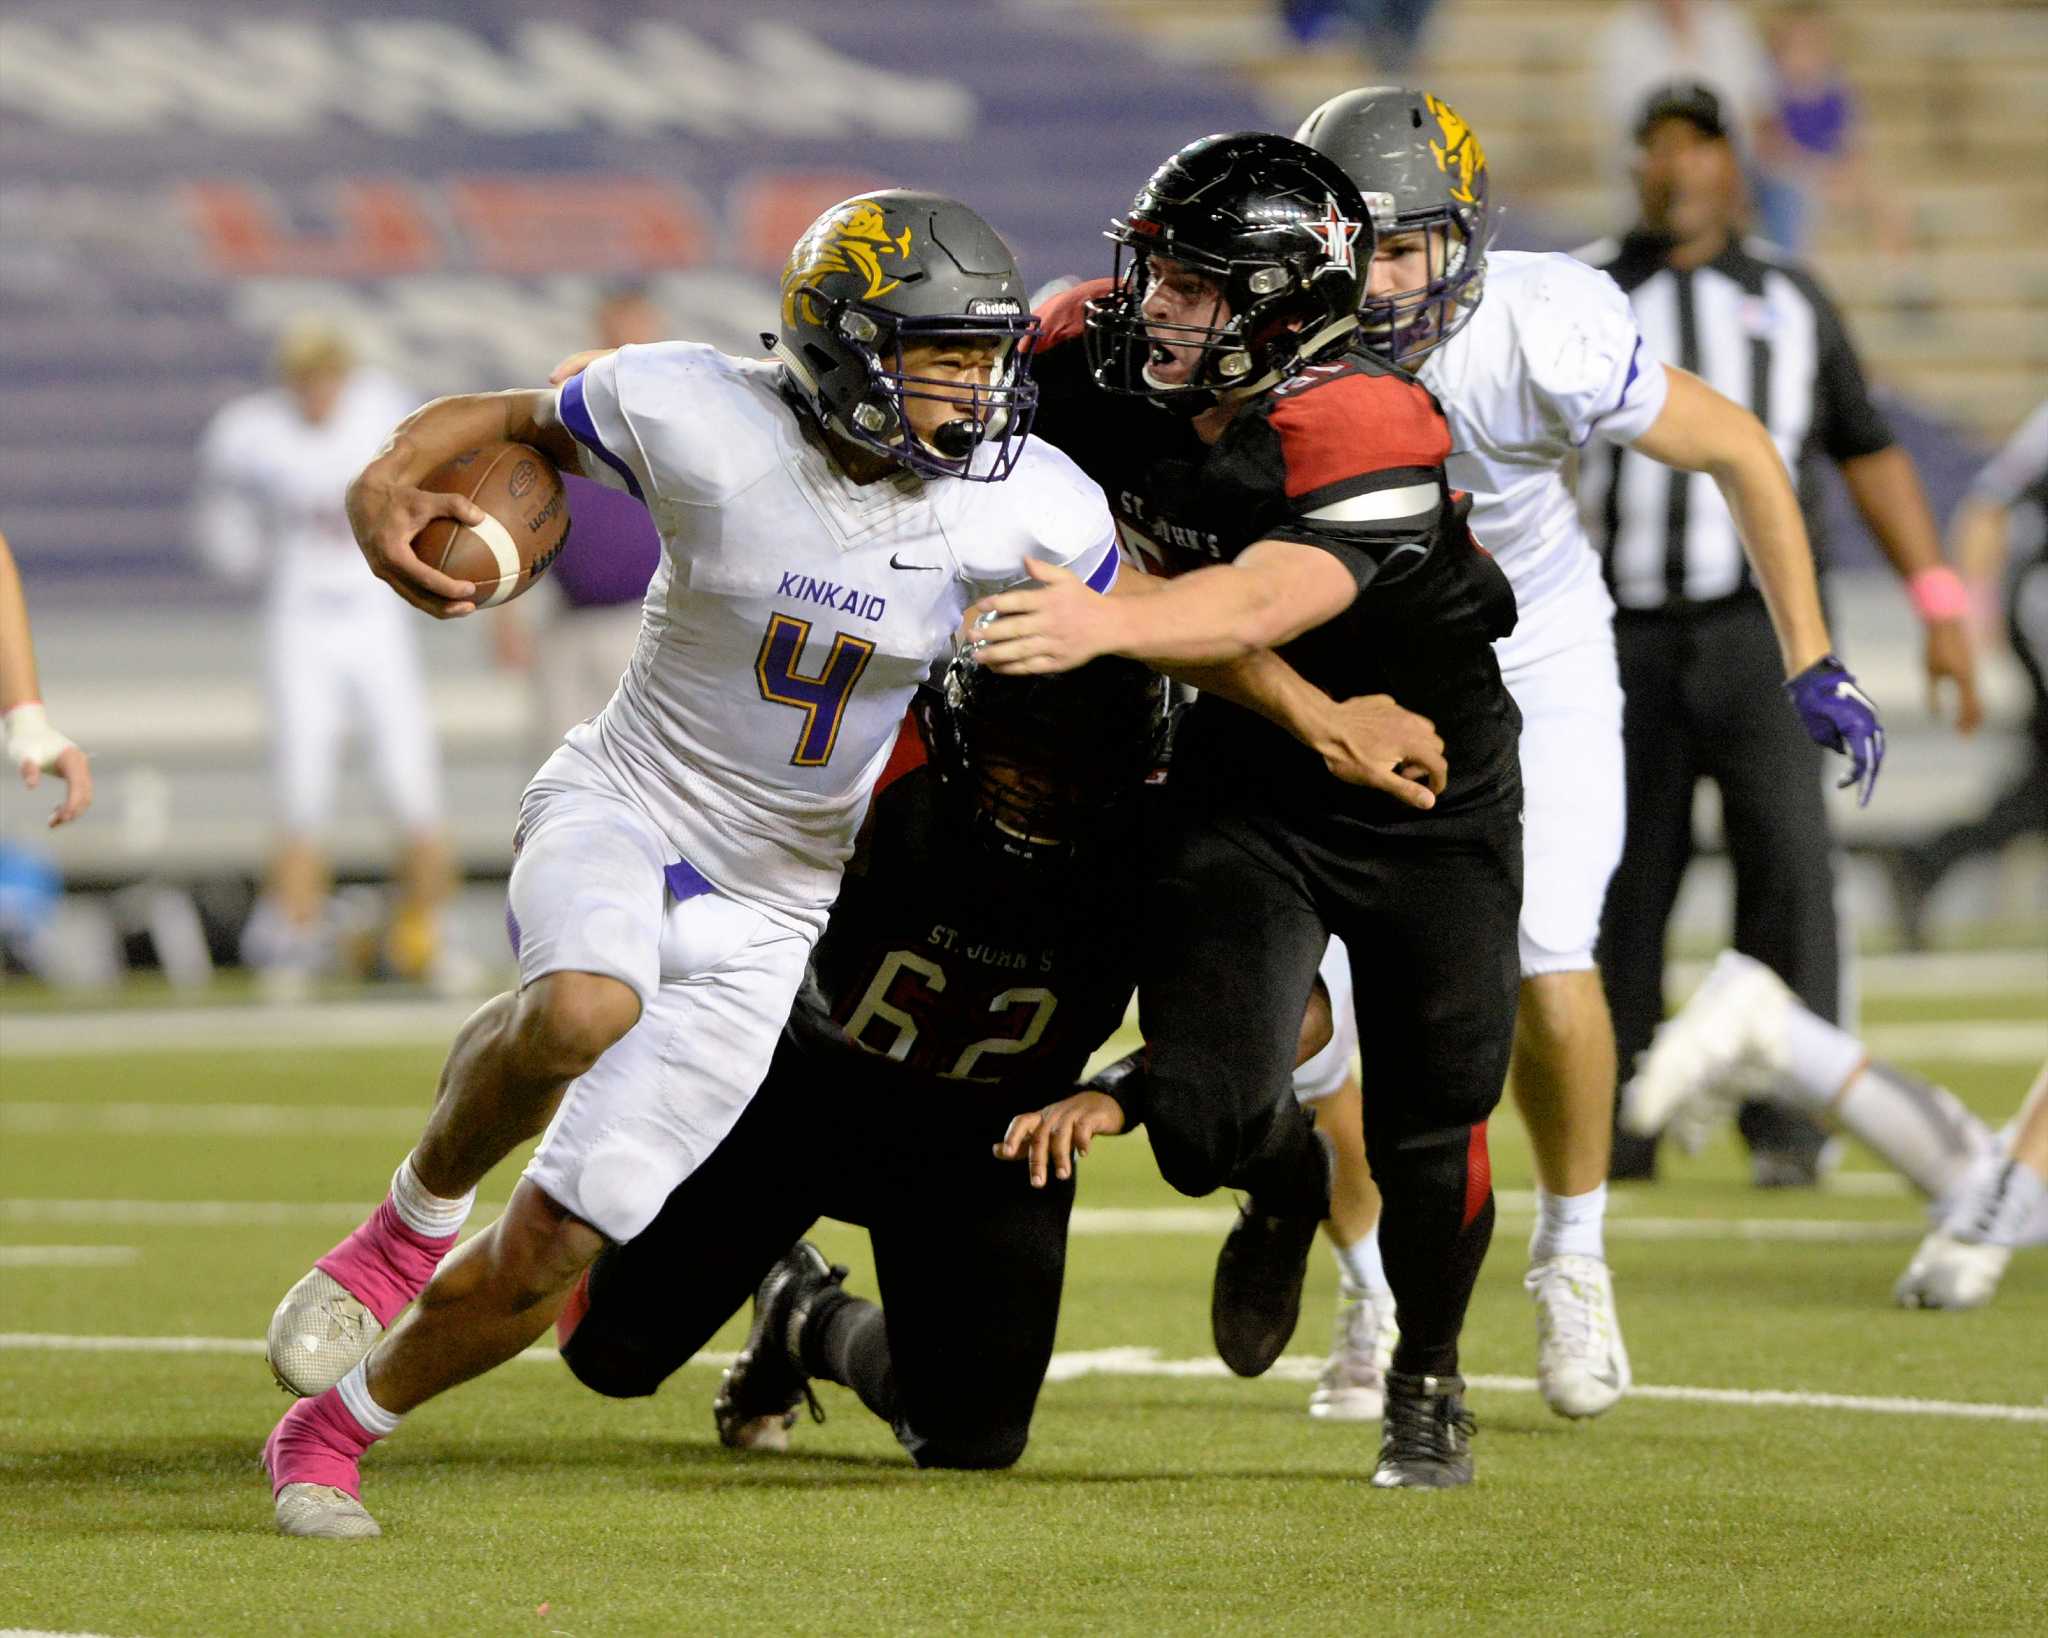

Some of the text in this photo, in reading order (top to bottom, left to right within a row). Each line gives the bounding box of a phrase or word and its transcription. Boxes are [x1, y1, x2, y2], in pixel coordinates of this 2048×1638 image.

[777, 570, 886, 623] KINKAID
[754, 611, 877, 767] 4
[842, 949, 1059, 1084] 62
